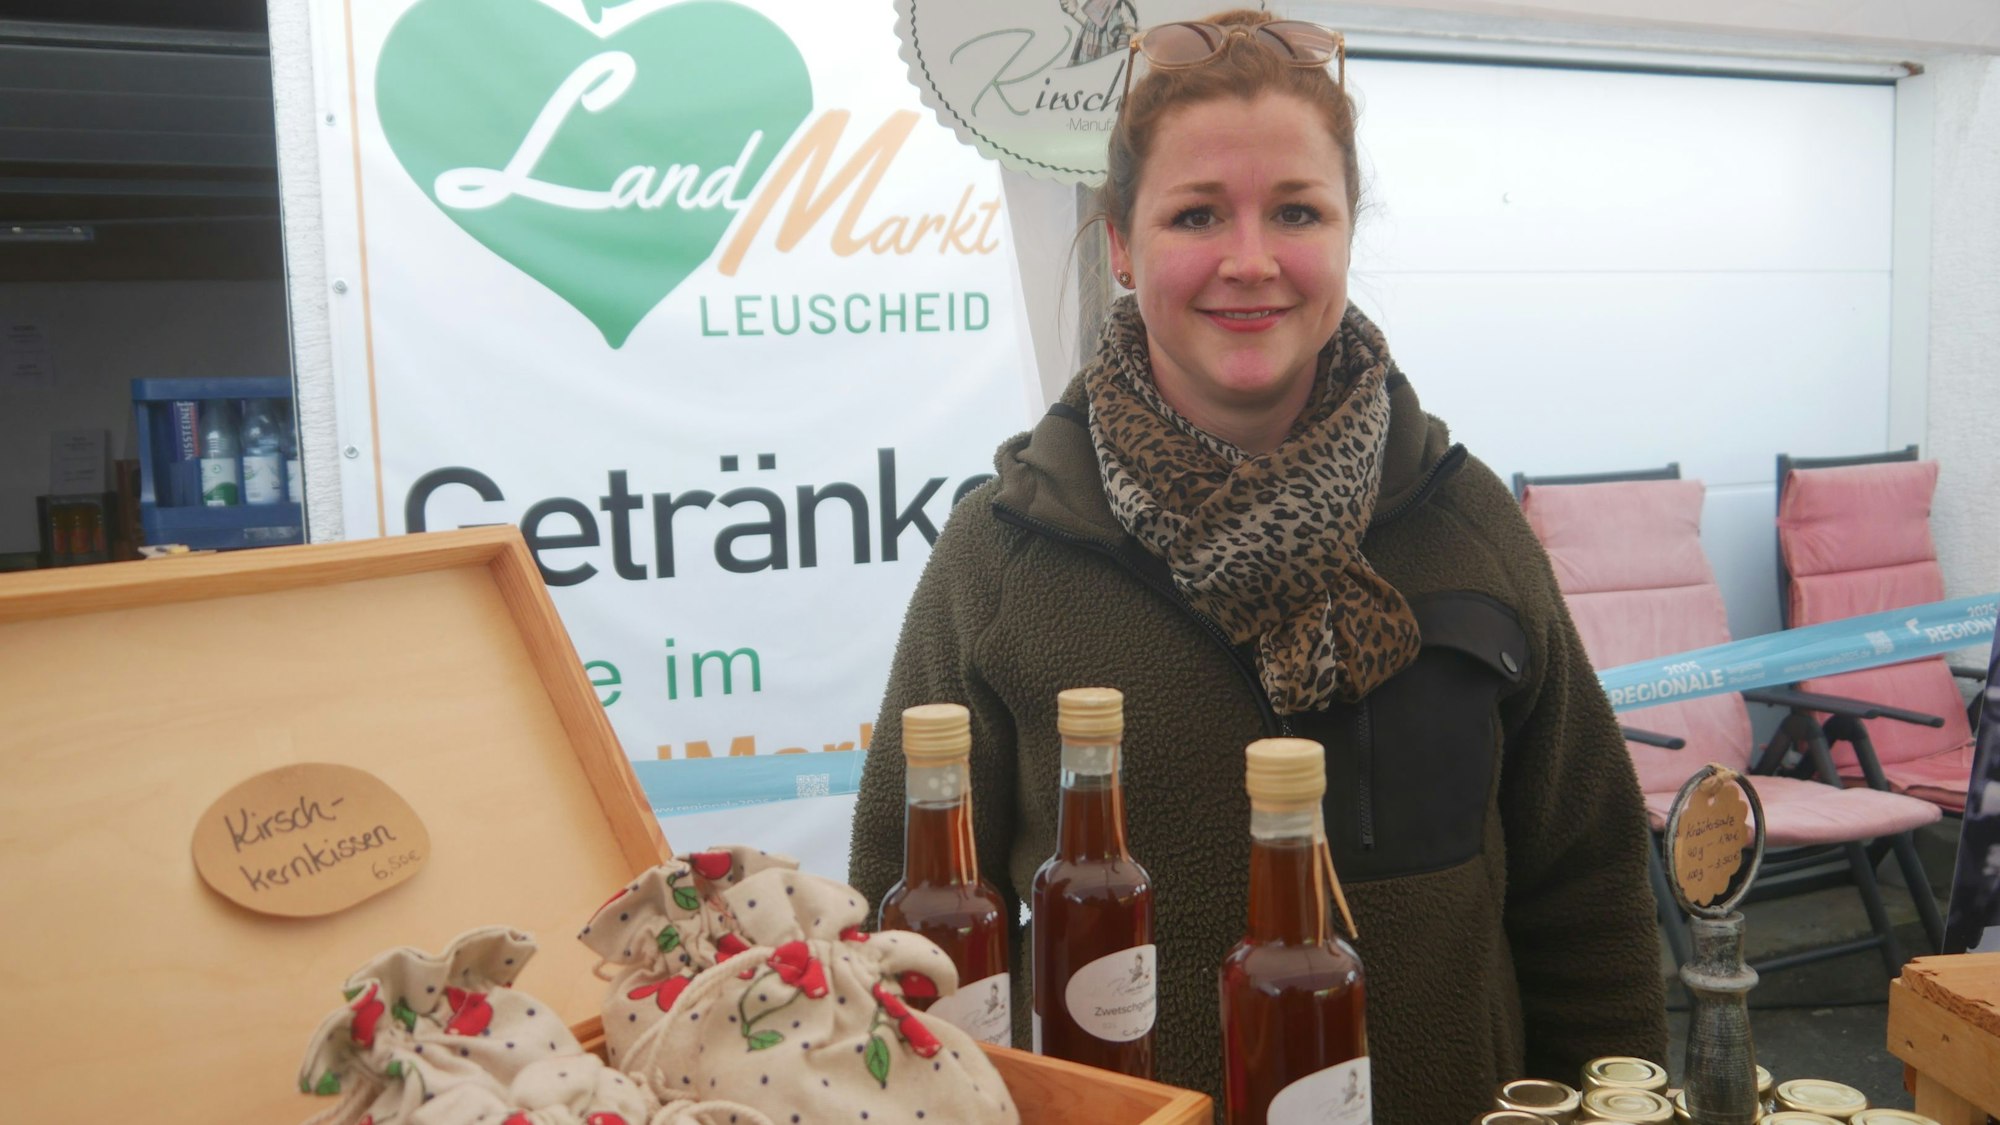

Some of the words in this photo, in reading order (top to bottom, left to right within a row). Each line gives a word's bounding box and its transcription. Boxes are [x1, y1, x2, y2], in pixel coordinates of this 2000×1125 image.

[699, 291, 990, 337] LEUSCHEID
[404, 446, 998, 587] Getränk
[665, 638, 761, 700] im
[1610, 669, 1725, 706] REGIONALE
[224, 796, 345, 853] Kirsch-
[240, 824, 396, 892] kernkissen
